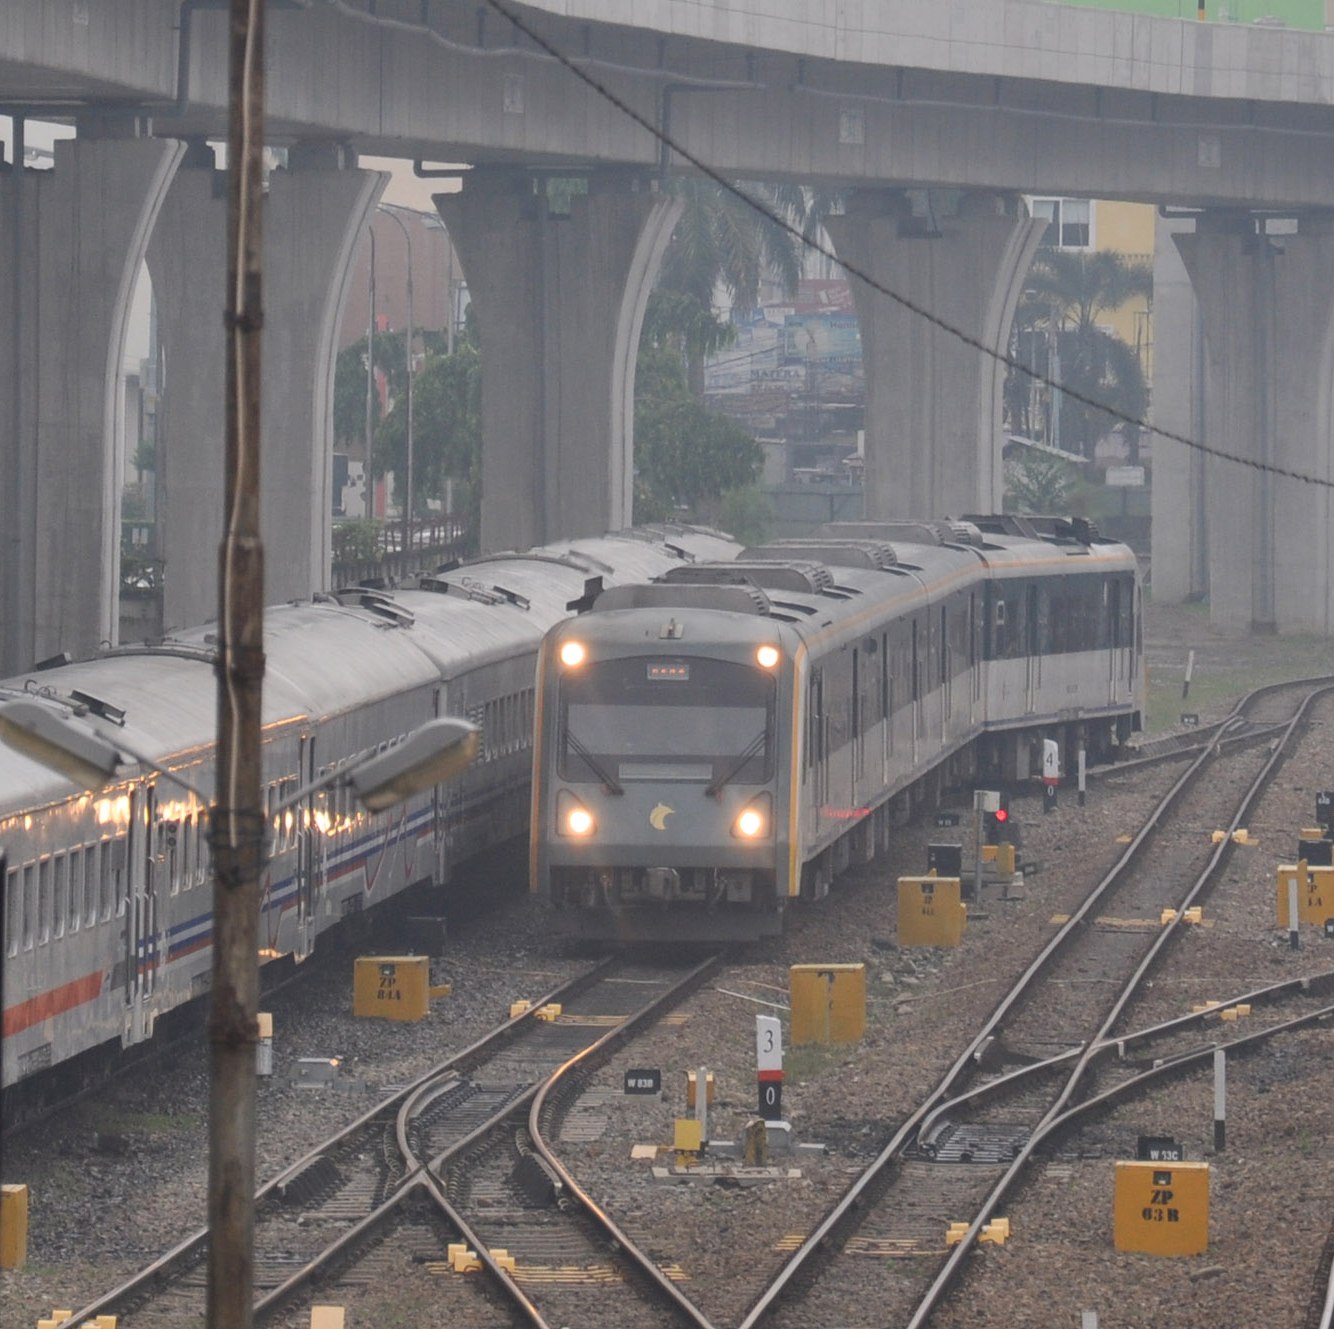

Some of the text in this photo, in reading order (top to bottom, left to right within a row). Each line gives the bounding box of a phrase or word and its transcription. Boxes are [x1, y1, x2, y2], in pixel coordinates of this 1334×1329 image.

[1045, 752, 1053, 767] 4
[379, 977, 396, 989] ZP
[763, 1029, 774, 1054] 3
[627, 1078, 637, 1089] W
[766, 1086, 775, 1106] 0
[1150, 1150, 1161, 1161] W
[1150, 1189, 1174, 1205] ZP
